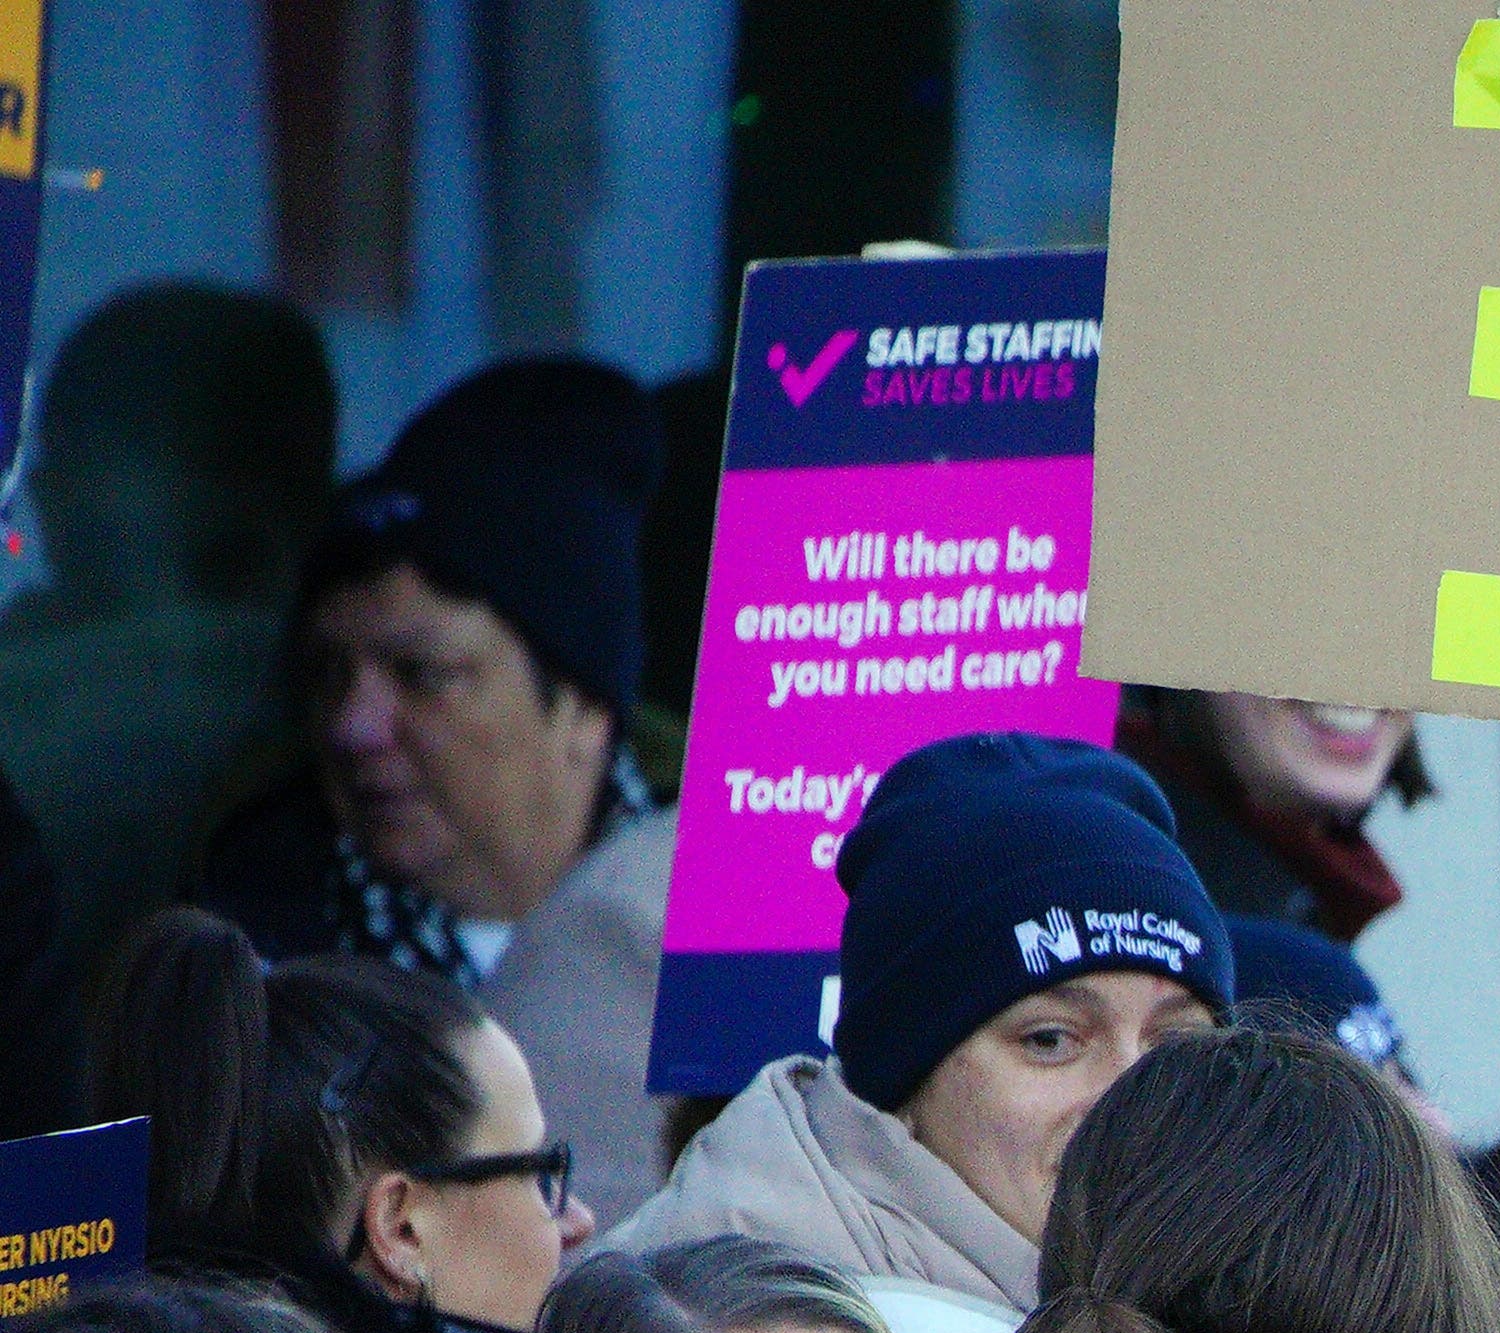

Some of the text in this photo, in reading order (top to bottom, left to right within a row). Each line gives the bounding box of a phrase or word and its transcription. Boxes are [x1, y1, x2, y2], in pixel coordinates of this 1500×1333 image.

[866, 320, 1101, 367] SAFE STAFFIN
[862, 363, 1075, 406] SAVES LIVES
[803, 526, 1056, 581] Will there be
[735, 590, 892, 648] enough
[898, 585, 995, 636] staff
[768, 640, 1063, 708] you need care?
[1085, 908, 1202, 956] Royal College
[1090, 933, 1183, 972] of Nursing
[30, 1217, 116, 1267] NYRSIO
